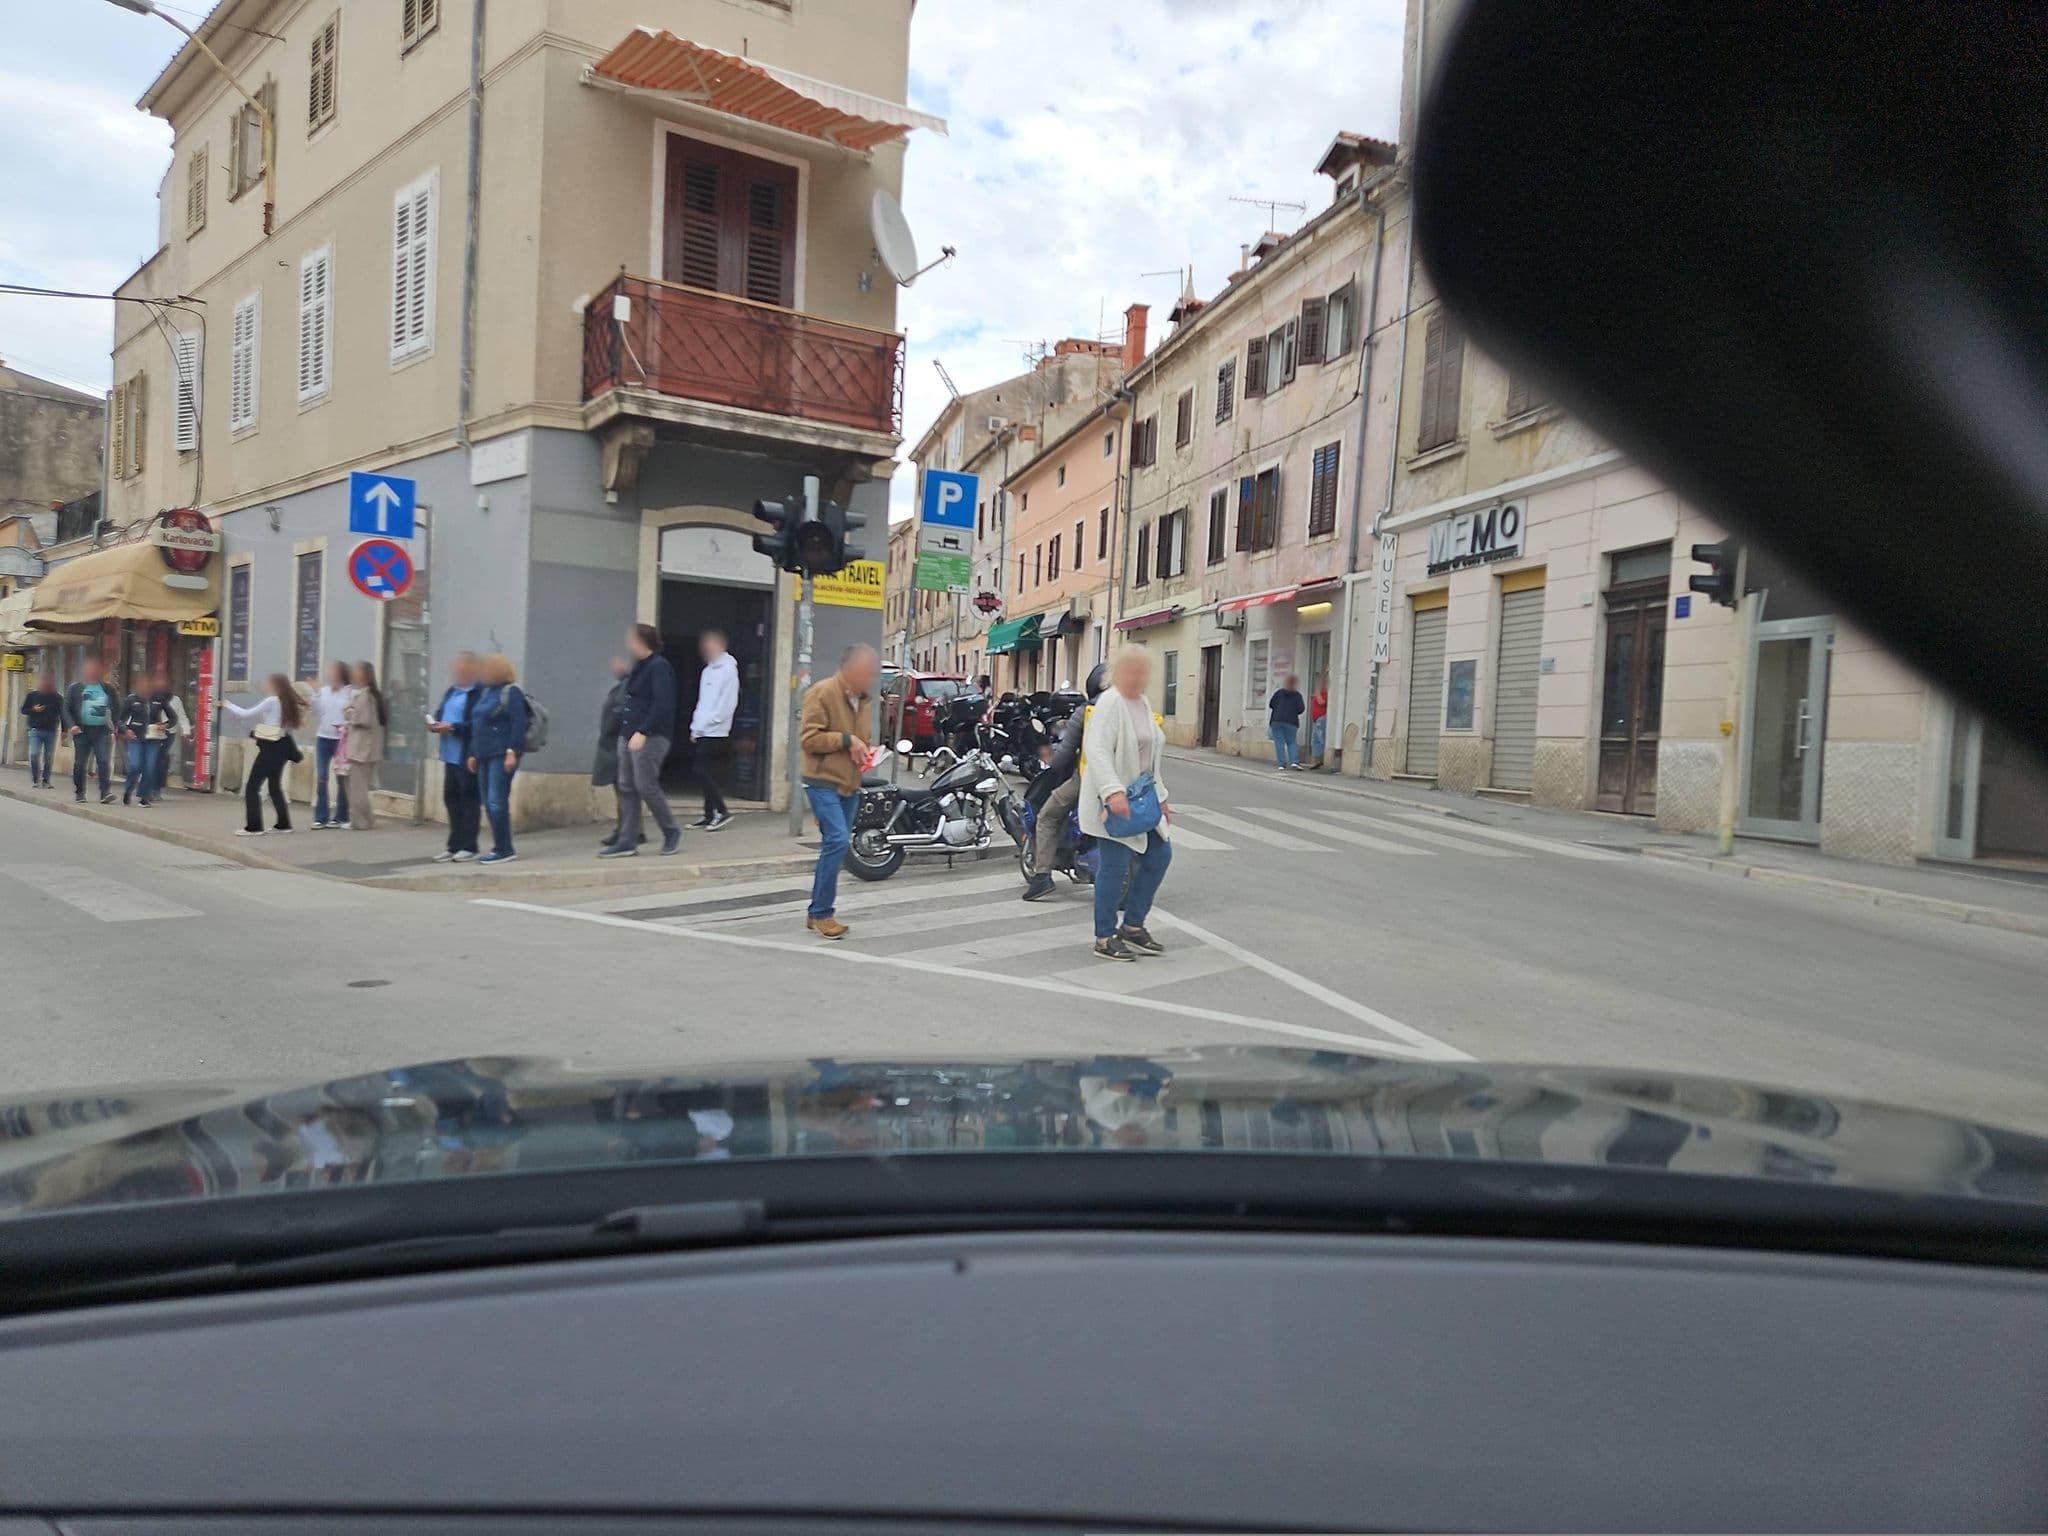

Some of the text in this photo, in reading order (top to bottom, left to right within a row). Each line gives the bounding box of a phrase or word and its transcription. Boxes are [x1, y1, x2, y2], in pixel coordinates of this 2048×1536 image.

[937, 480, 963, 516] P
[1428, 506, 1519, 564] MEMO
[1375, 537, 1395, 656] MUSEUM
[181, 620, 216, 632] ATM
